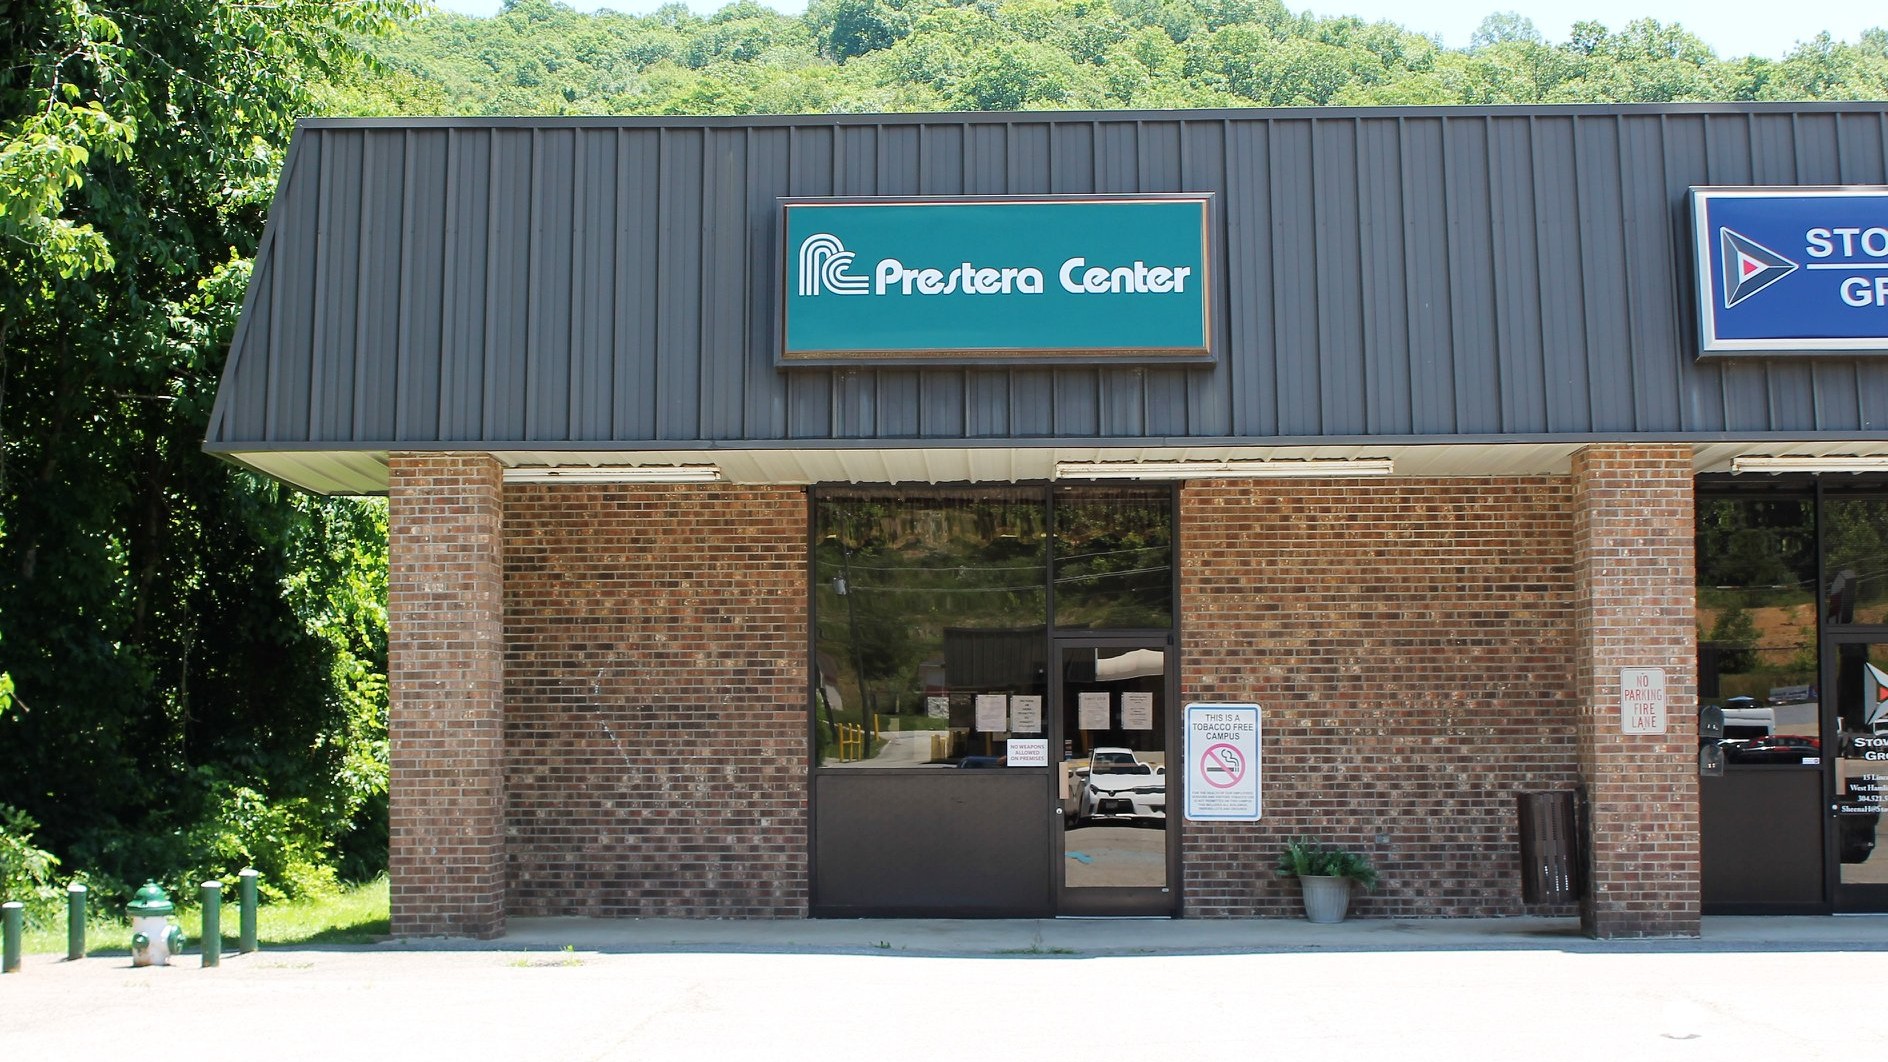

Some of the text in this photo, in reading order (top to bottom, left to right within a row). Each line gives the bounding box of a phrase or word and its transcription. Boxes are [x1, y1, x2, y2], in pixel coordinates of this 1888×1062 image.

[875, 256, 1191, 296] Prestera Center
[1636, 675, 1649, 687] NO
[1624, 689, 1663, 701] PARKING
[1634, 703, 1656, 715] FIRE
[1205, 714, 1223, 722] THIS
[1225, 714, 1233, 722] IS
[1632, 716, 1657, 728] LANE
[1192, 723, 1254, 731] TOBACCO FREE
[1205, 732, 1240, 740] CAMPUS
[1865, 750, 1888, 760] GR
